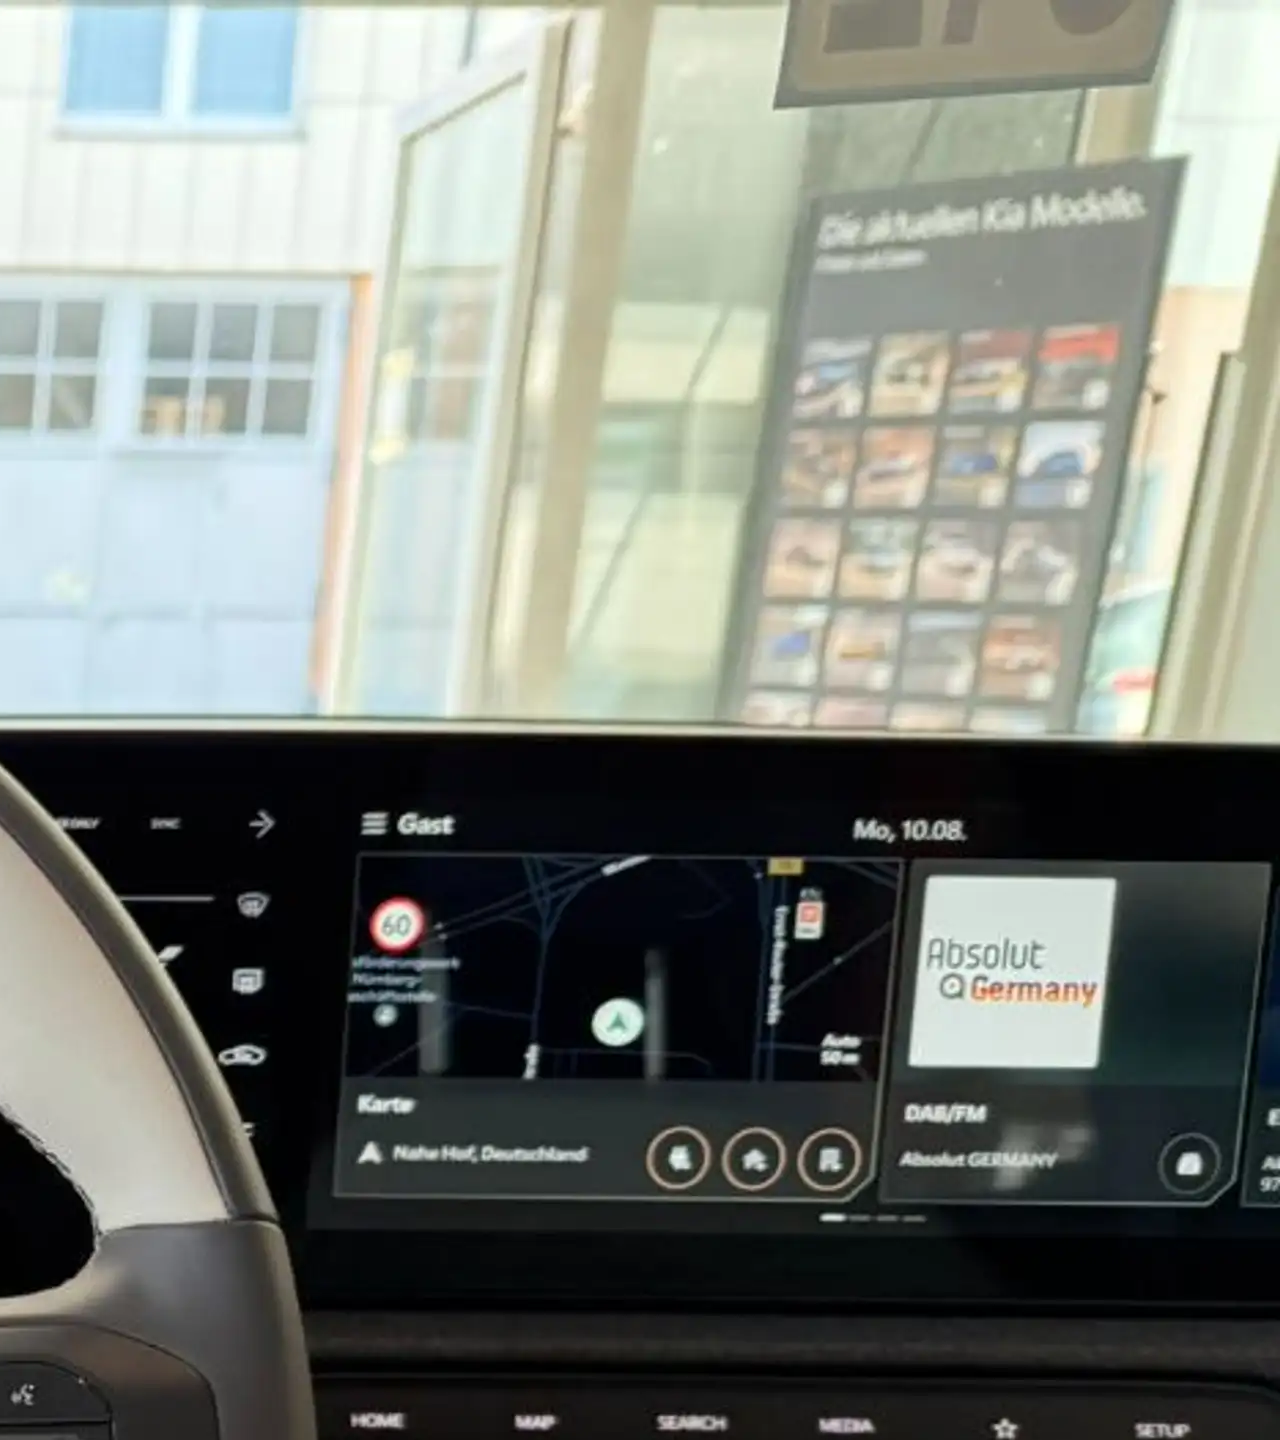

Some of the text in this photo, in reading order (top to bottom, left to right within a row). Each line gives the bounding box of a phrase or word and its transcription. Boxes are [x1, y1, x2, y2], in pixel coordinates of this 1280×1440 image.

[982, 197, 1026, 234] Kia
[396, 812, 455, 836] Gast
[852, 818, 967, 844] Mo, 10.08.
[381, 913, 412, 938] 60
[926, 936, 1046, 972] Absolut
[971, 976, 1098, 1008] Germany
[821, 1033, 862, 1049] Auto
[357, 1094, 416, 1114] Karte
[904, 1103, 988, 1124] DAB/FM
[392, 1144, 441, 1161] Nahe
[479, 1144, 589, 1163] Deutschland
[898, 1150, 1061, 1170] Absolut GERMANY
[350, 1412, 404, 1429] HOME
[514, 1414, 556, 1431] MAP
[657, 1414, 728, 1431] SEARCH
[818, 1417, 875, 1434] MEDIA
[1134, 1423, 1191, 1439] SETUP
